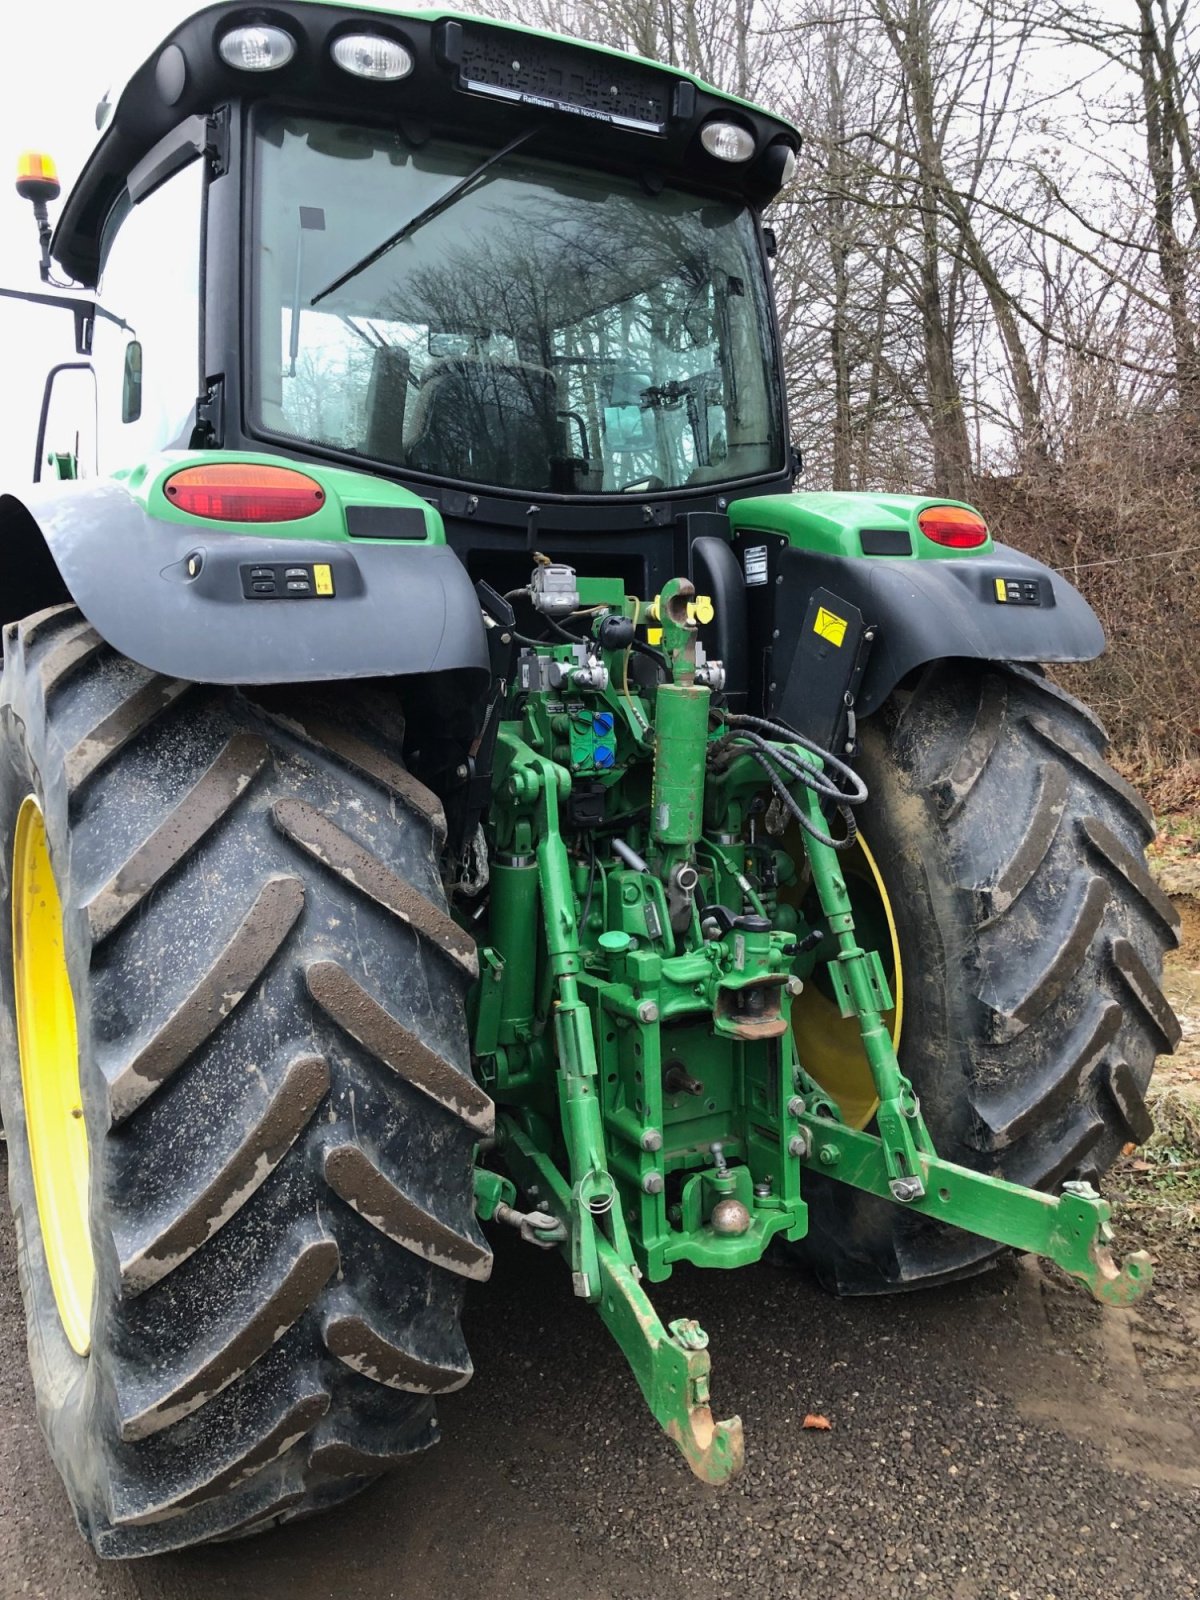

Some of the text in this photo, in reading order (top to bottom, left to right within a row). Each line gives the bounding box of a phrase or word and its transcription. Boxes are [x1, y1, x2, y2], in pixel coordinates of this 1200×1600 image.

[522, 94, 610, 121] Raiffeisen Technik Nord-West
